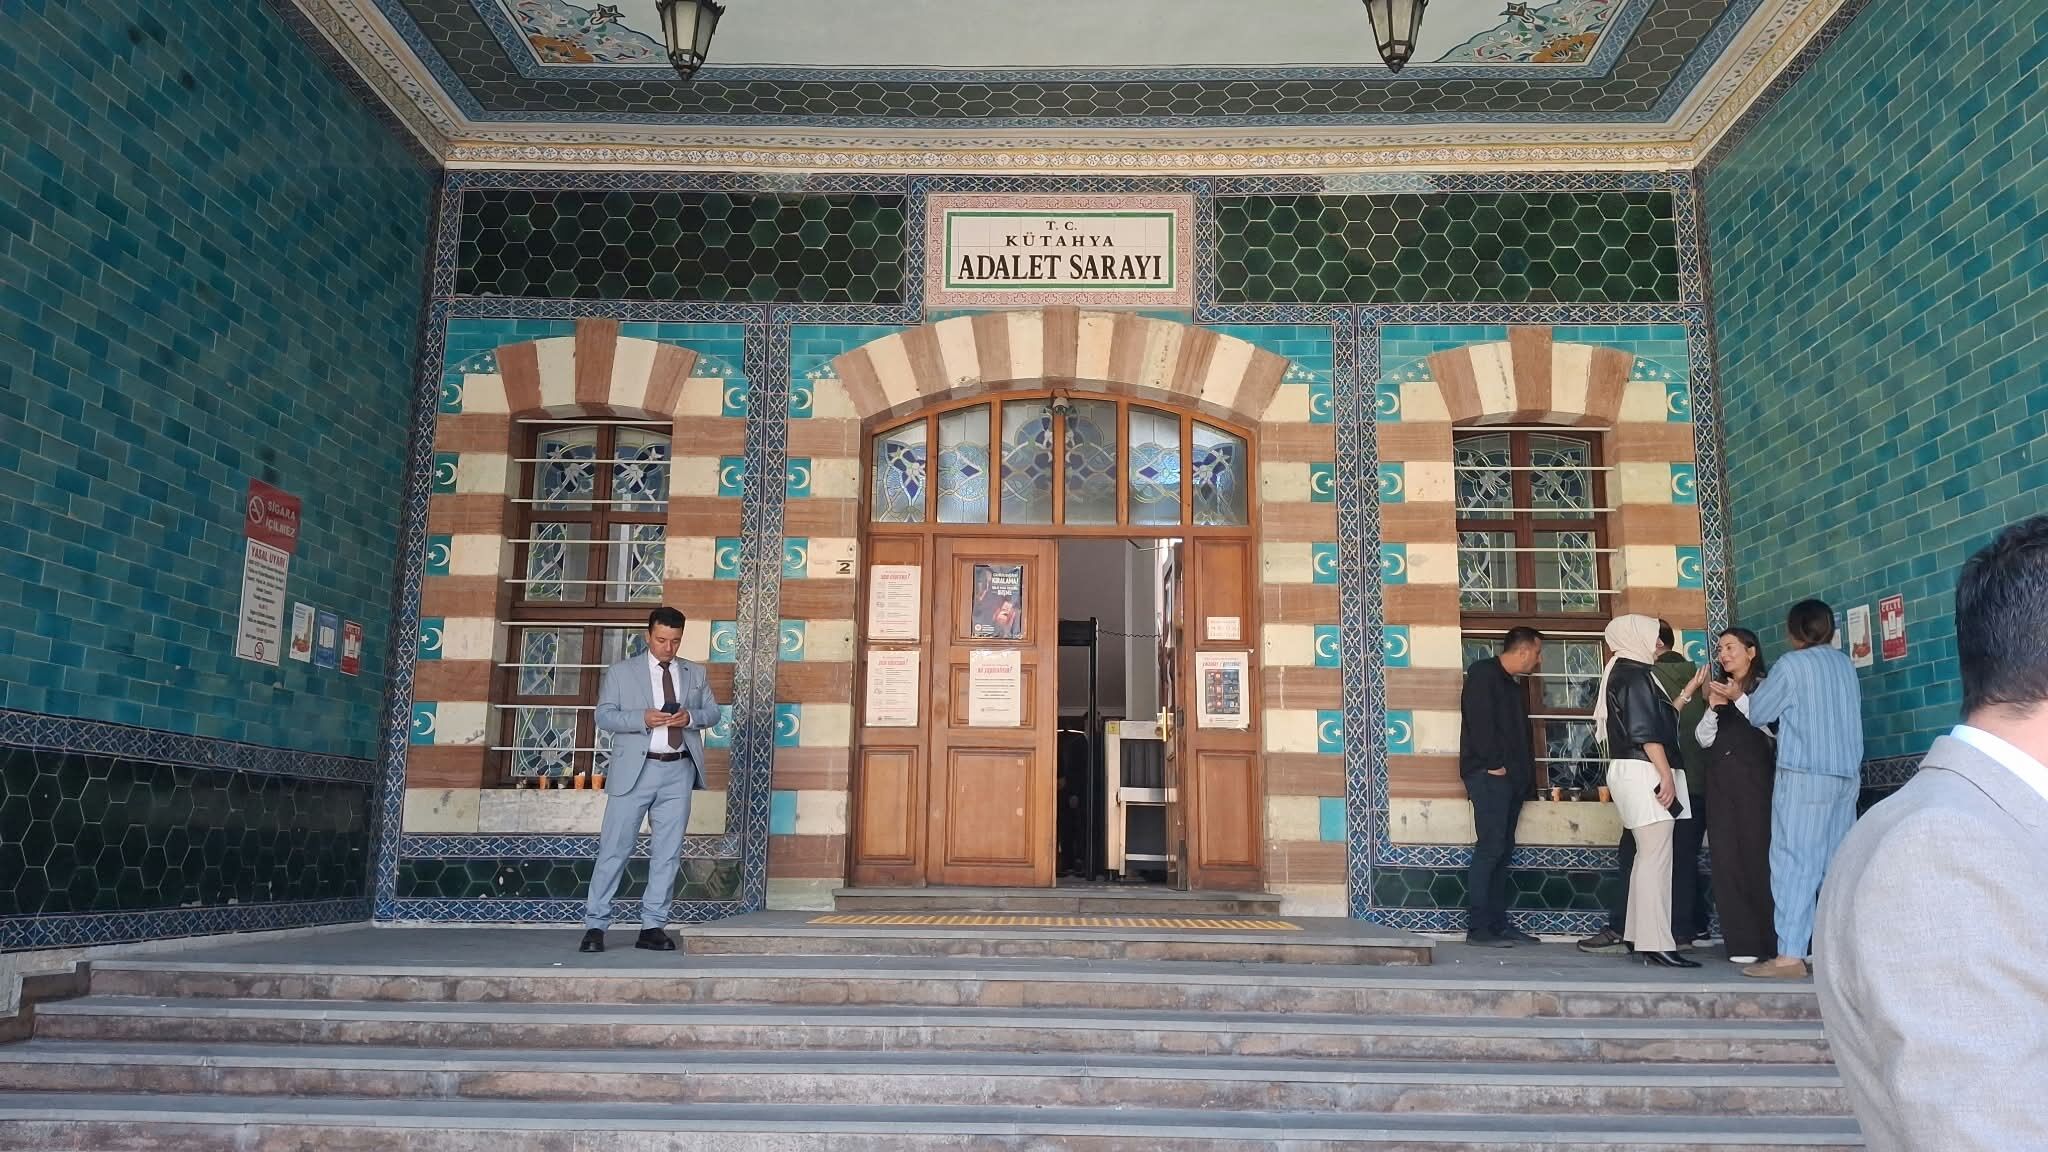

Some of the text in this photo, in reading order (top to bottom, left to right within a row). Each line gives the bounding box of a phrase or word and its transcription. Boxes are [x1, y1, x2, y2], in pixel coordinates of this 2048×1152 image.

[1045, 220, 1078, 231] T. C.
[1005, 232, 1115, 247] KÜTAHYA
[958, 254, 1162, 280] ADALET SARAYI
[267, 500, 296, 521] SİGARA
